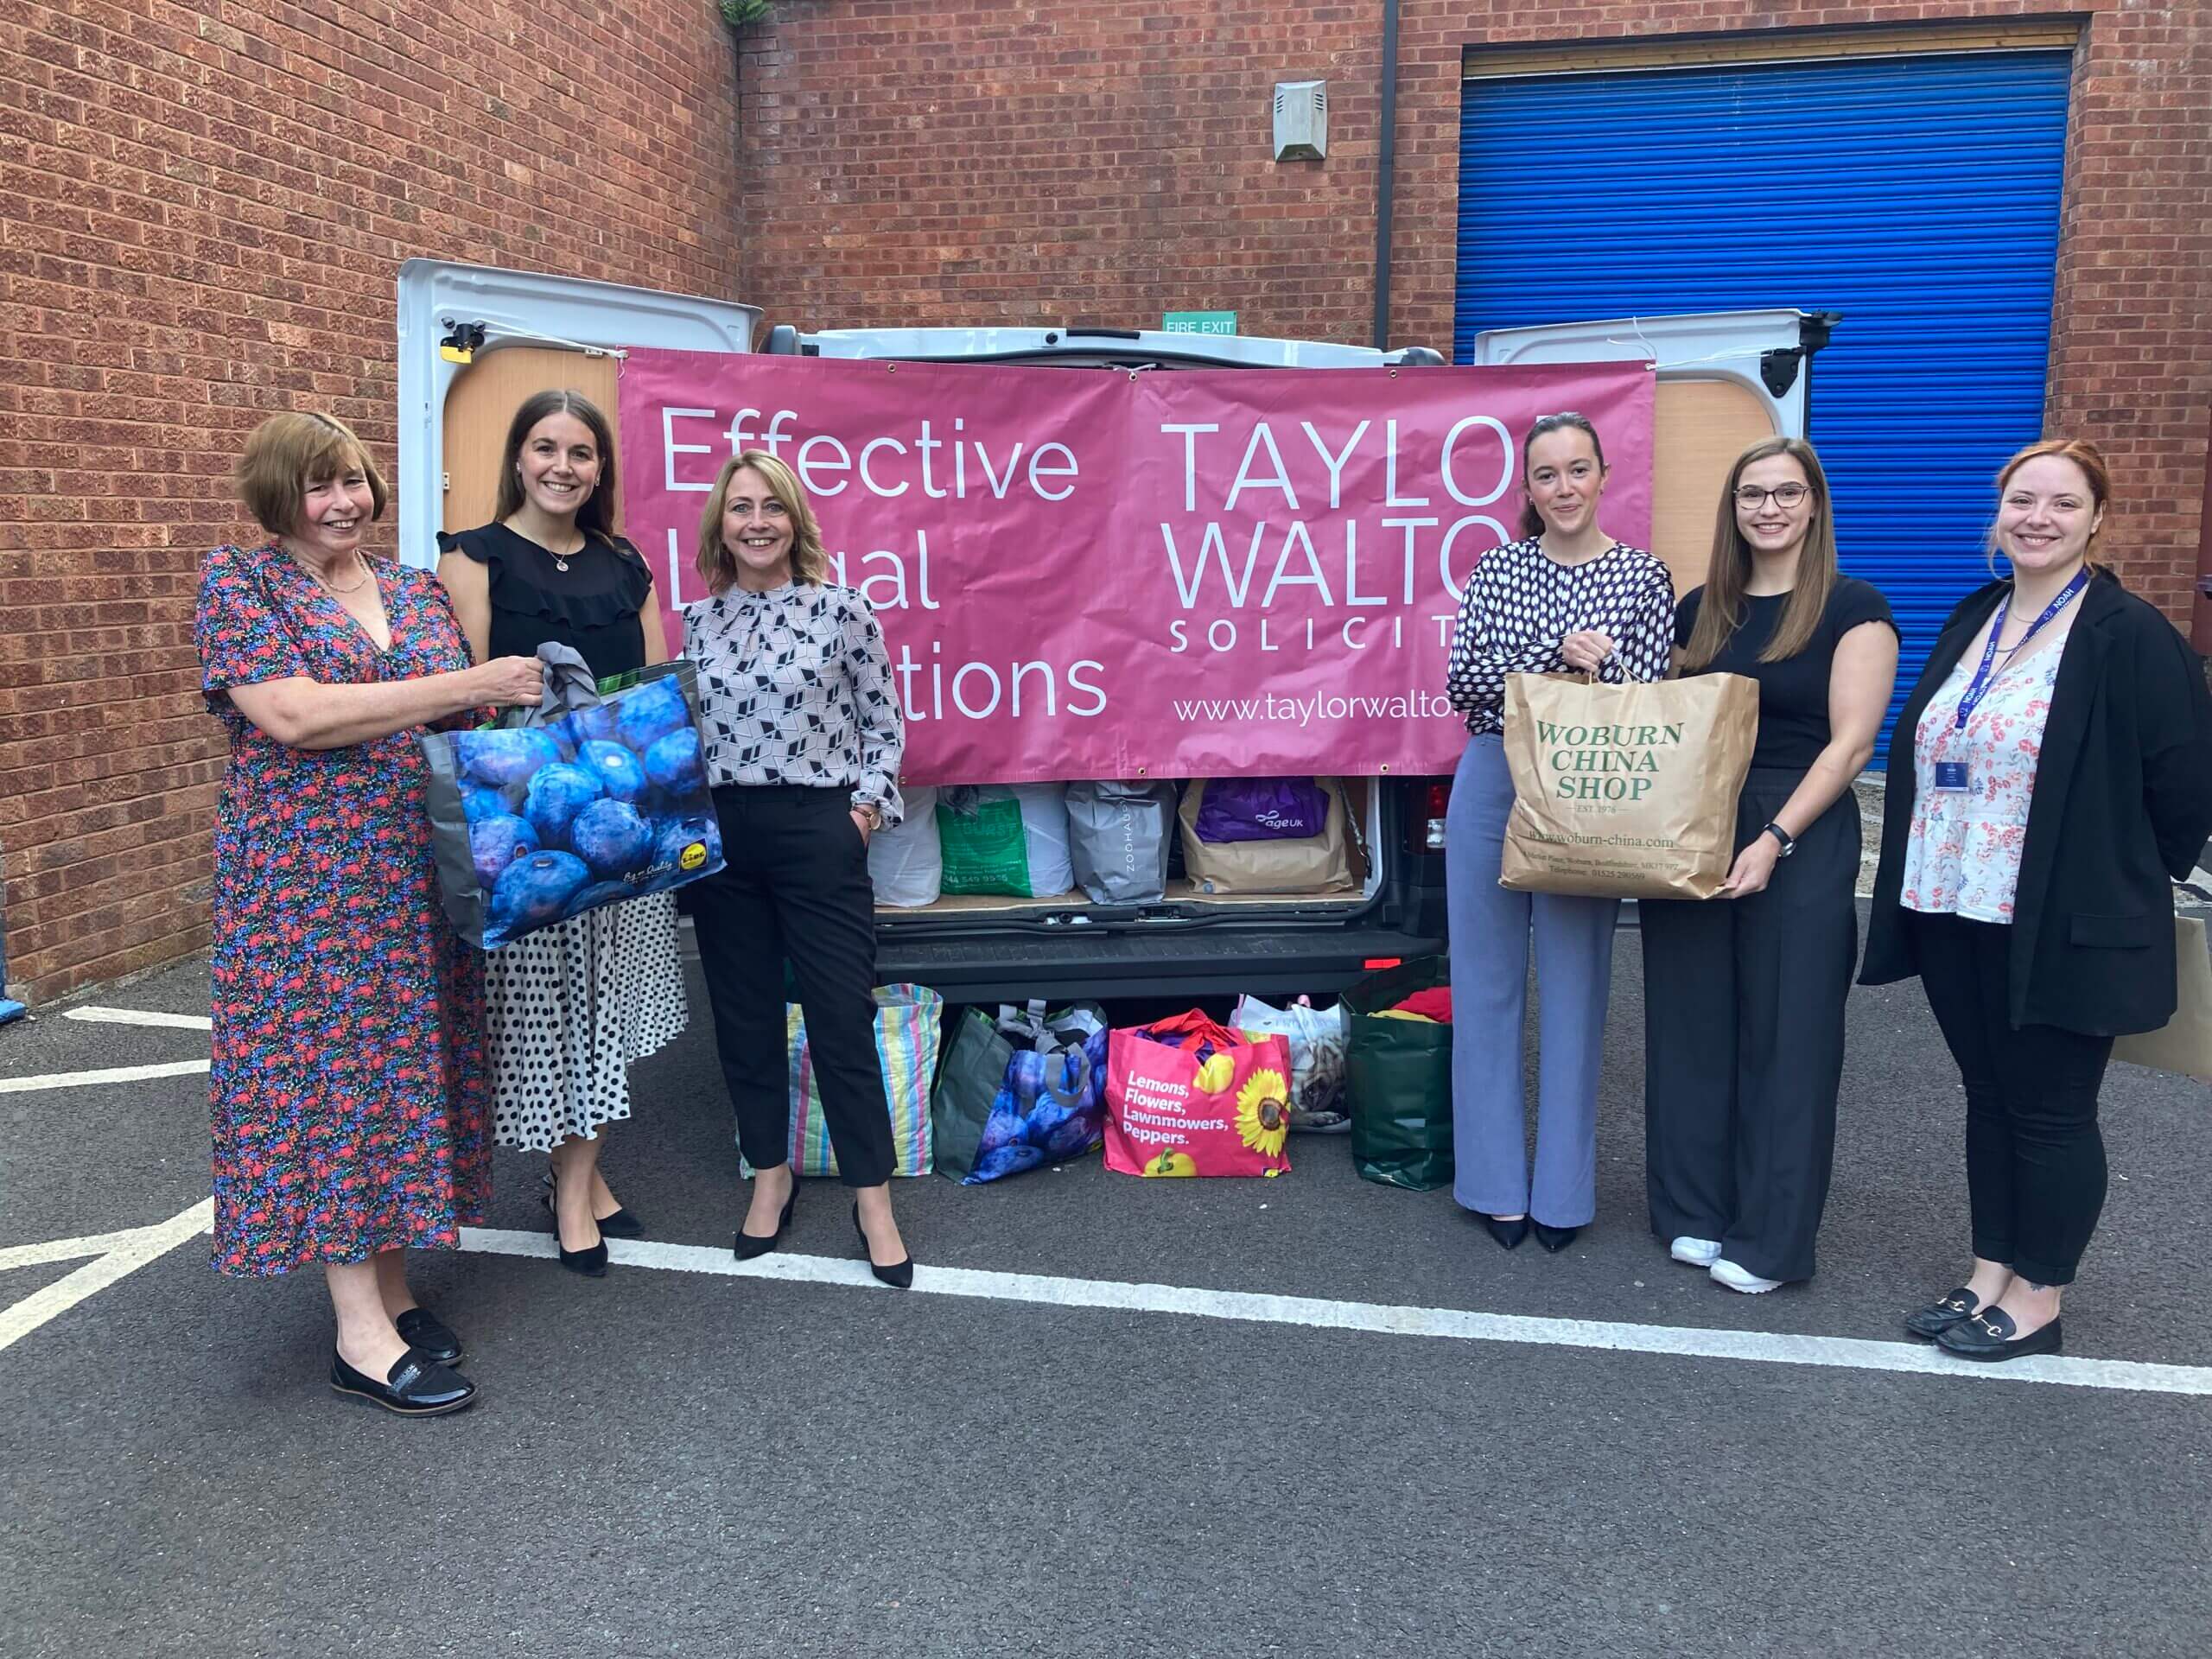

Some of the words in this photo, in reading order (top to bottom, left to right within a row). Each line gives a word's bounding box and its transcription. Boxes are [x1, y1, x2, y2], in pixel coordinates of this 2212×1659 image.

[1166, 321, 1197, 334] FIRE
[1202, 321, 1233, 334] EXIT
[662, 407, 1079, 501] Effective
[1160, 415, 1516, 512] TAYLO
[667, 529, 940, 611] Lal
[1160, 516, 1511, 609] WALTO
[2052, 588, 2075, 609] NOAH
[1170, 615, 1455, 652] SOLICIT
[896, 642, 1107, 722] tions
[1173, 690, 1459, 728] www.taylorwalto
[1535, 721, 1686, 747] WOBURN
[1552, 749, 1660, 773] CHINA
[1556, 776, 1653, 802] SHOP
[1529, 830, 1675, 849] www.woburn-china.com
[1127, 1070, 1190, 1099] Lemons,
[1125, 1087, 1187, 1116] Flowers,
[1122, 1103, 1230, 1131] Lawnmowers,
[1122, 1120, 1190, 1146] Peppers.
